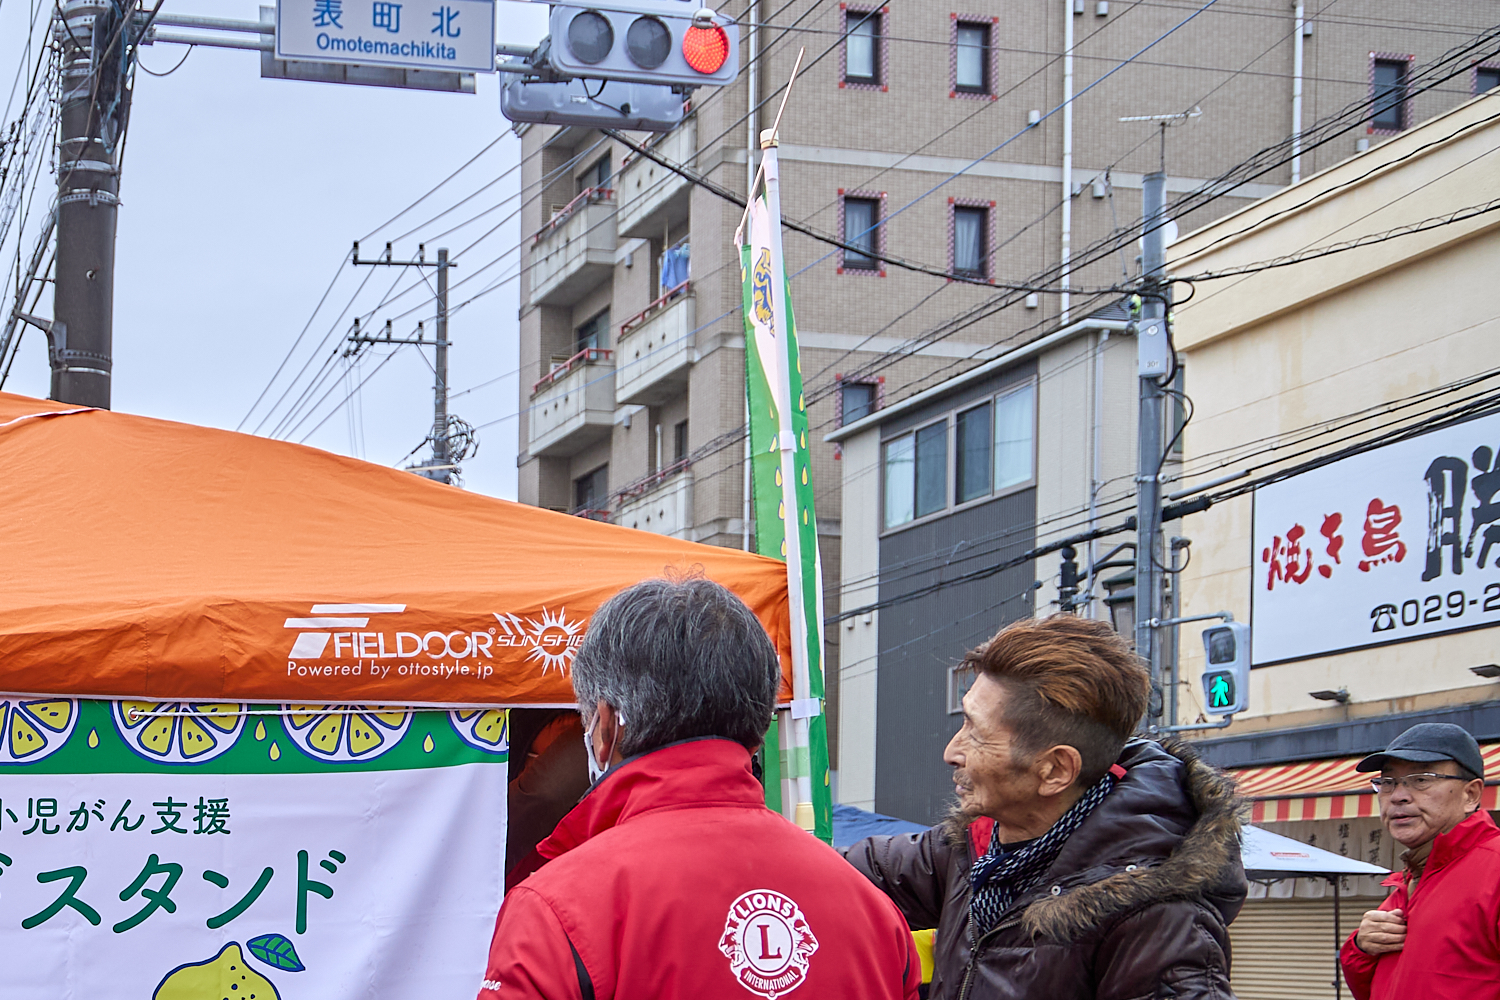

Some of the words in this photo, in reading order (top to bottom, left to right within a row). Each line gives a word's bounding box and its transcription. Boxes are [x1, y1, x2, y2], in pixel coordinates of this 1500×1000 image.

[312, 0, 461, 37] 表町北
[316, 32, 457, 60] Omotemachikita
[334, 630, 494, 659] FIELDOOR
[496, 634, 541, 647] SUN
[542, 634, 586, 647] SHIE
[287, 660, 363, 677] Powered
[369, 659, 391, 679] by
[397, 660, 494, 680] ottostyle.jp
[735, 893, 794, 919] LIONS
[756, 924, 783, 960] L
[743, 969, 800, 991] INTERNATIONAL
